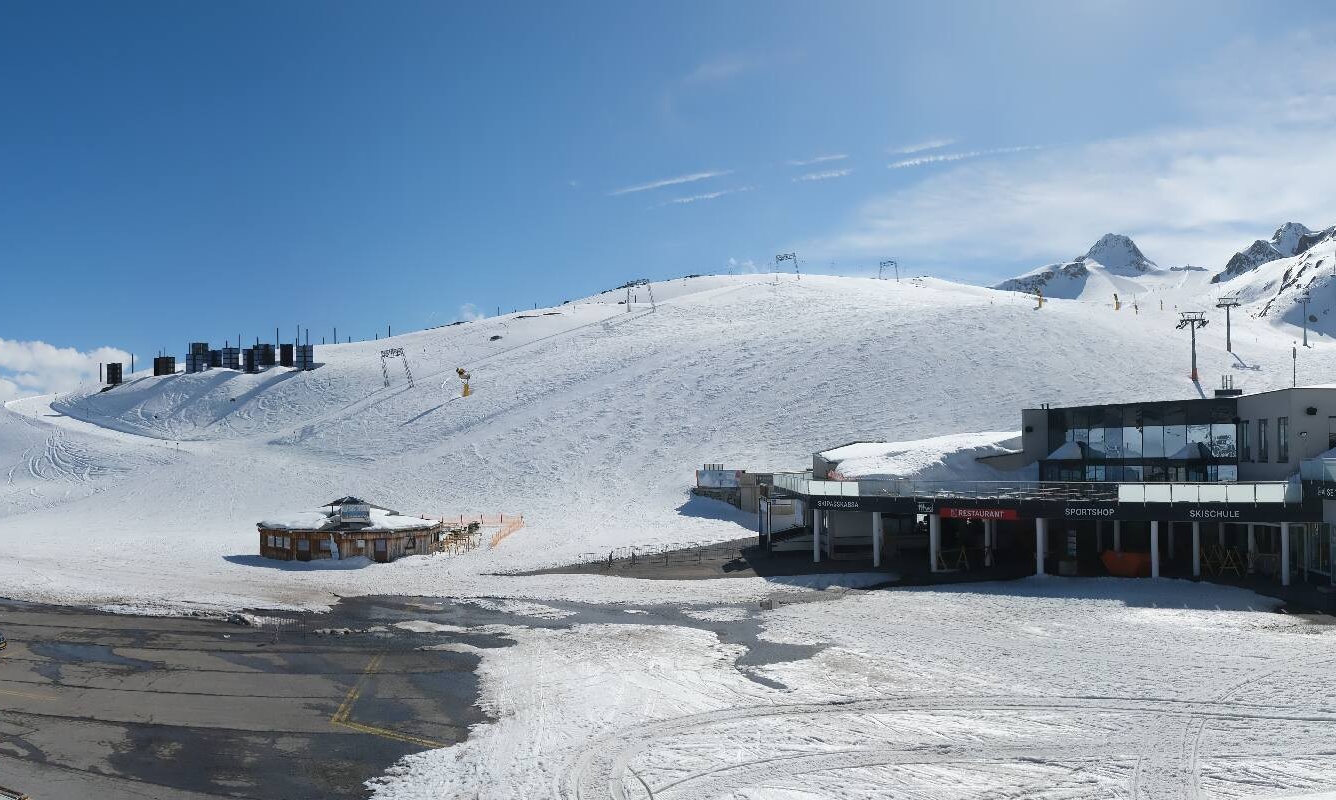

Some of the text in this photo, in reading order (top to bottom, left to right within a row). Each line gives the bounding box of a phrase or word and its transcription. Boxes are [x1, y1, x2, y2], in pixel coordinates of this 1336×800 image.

[958, 509, 1005, 518] RESTAURANT
[1065, 508, 1115, 516] SPORTSHOP
[1189, 509, 1240, 518] SKISCHULE
